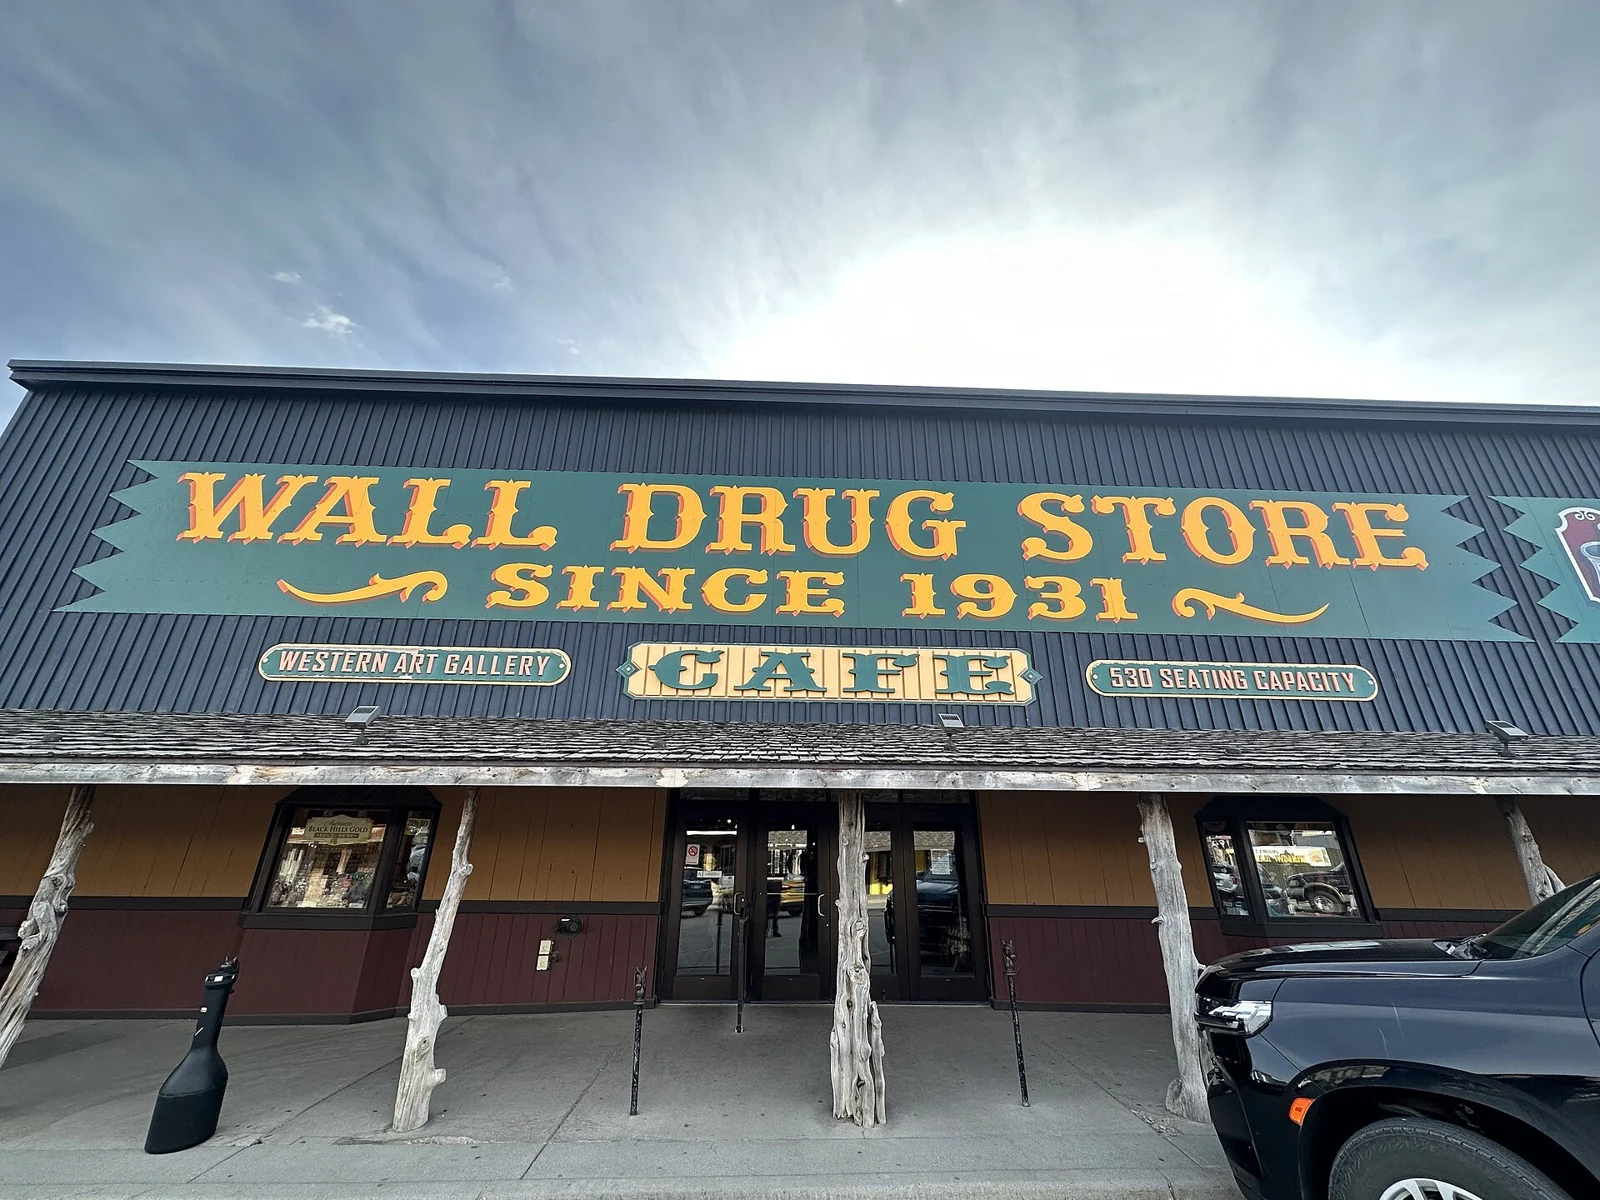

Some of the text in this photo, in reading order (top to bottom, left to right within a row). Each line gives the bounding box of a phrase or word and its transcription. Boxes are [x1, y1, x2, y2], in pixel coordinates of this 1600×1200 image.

[176, 471, 1430, 571] WALL DRUG STORE
[485, 562, 1139, 624] SINCE 1931
[277, 651, 552, 677] WESTERN ART GALLERY
[647, 649, 1016, 695] CAFE
[1109, 667, 1357, 694] 530 SEATING CAPACITY
